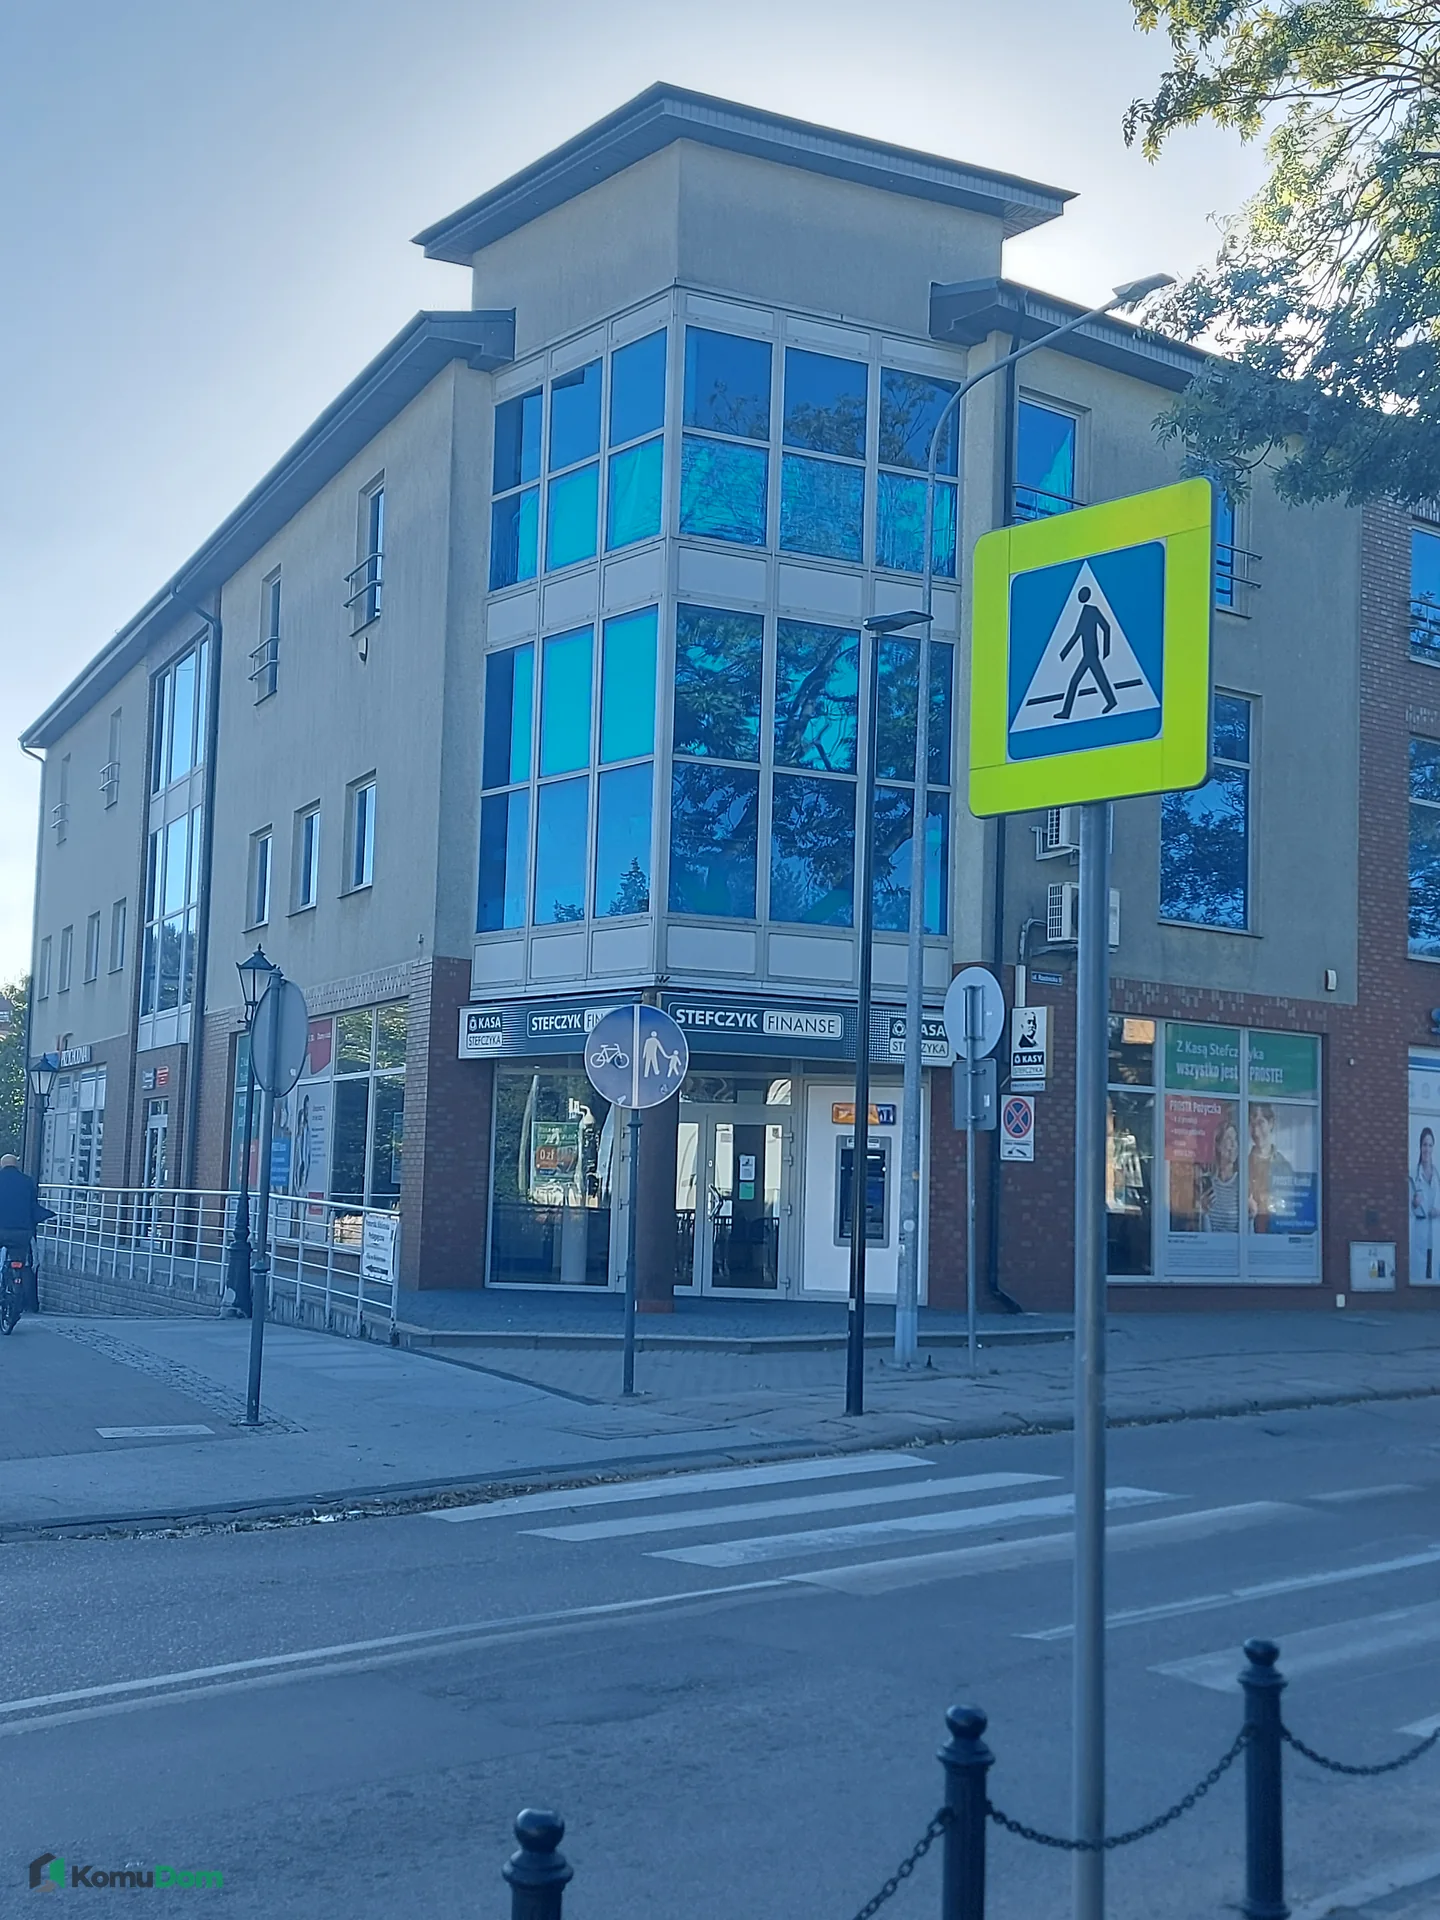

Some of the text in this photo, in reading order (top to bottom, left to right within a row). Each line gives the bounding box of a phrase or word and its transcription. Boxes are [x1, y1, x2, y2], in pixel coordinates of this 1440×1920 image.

[478, 1016, 501, 1029] KASA
[531, 1013, 582, 1031] STEFCZYK
[676, 1009, 836, 1034] STEFCZYK FINANSE
[920, 1023, 946, 1037] ASA
[468, 1033, 501, 1046] STEFCZYKA
[892, 1041, 946, 1055] STZYKA
[1176, 1040, 1184, 1053] Z
[1185, 1040, 1208, 1059] Kasą
[1022, 1054, 1043, 1064] KASY
[1176, 1062, 1283, 1083] wszystko jest PROSTE!
